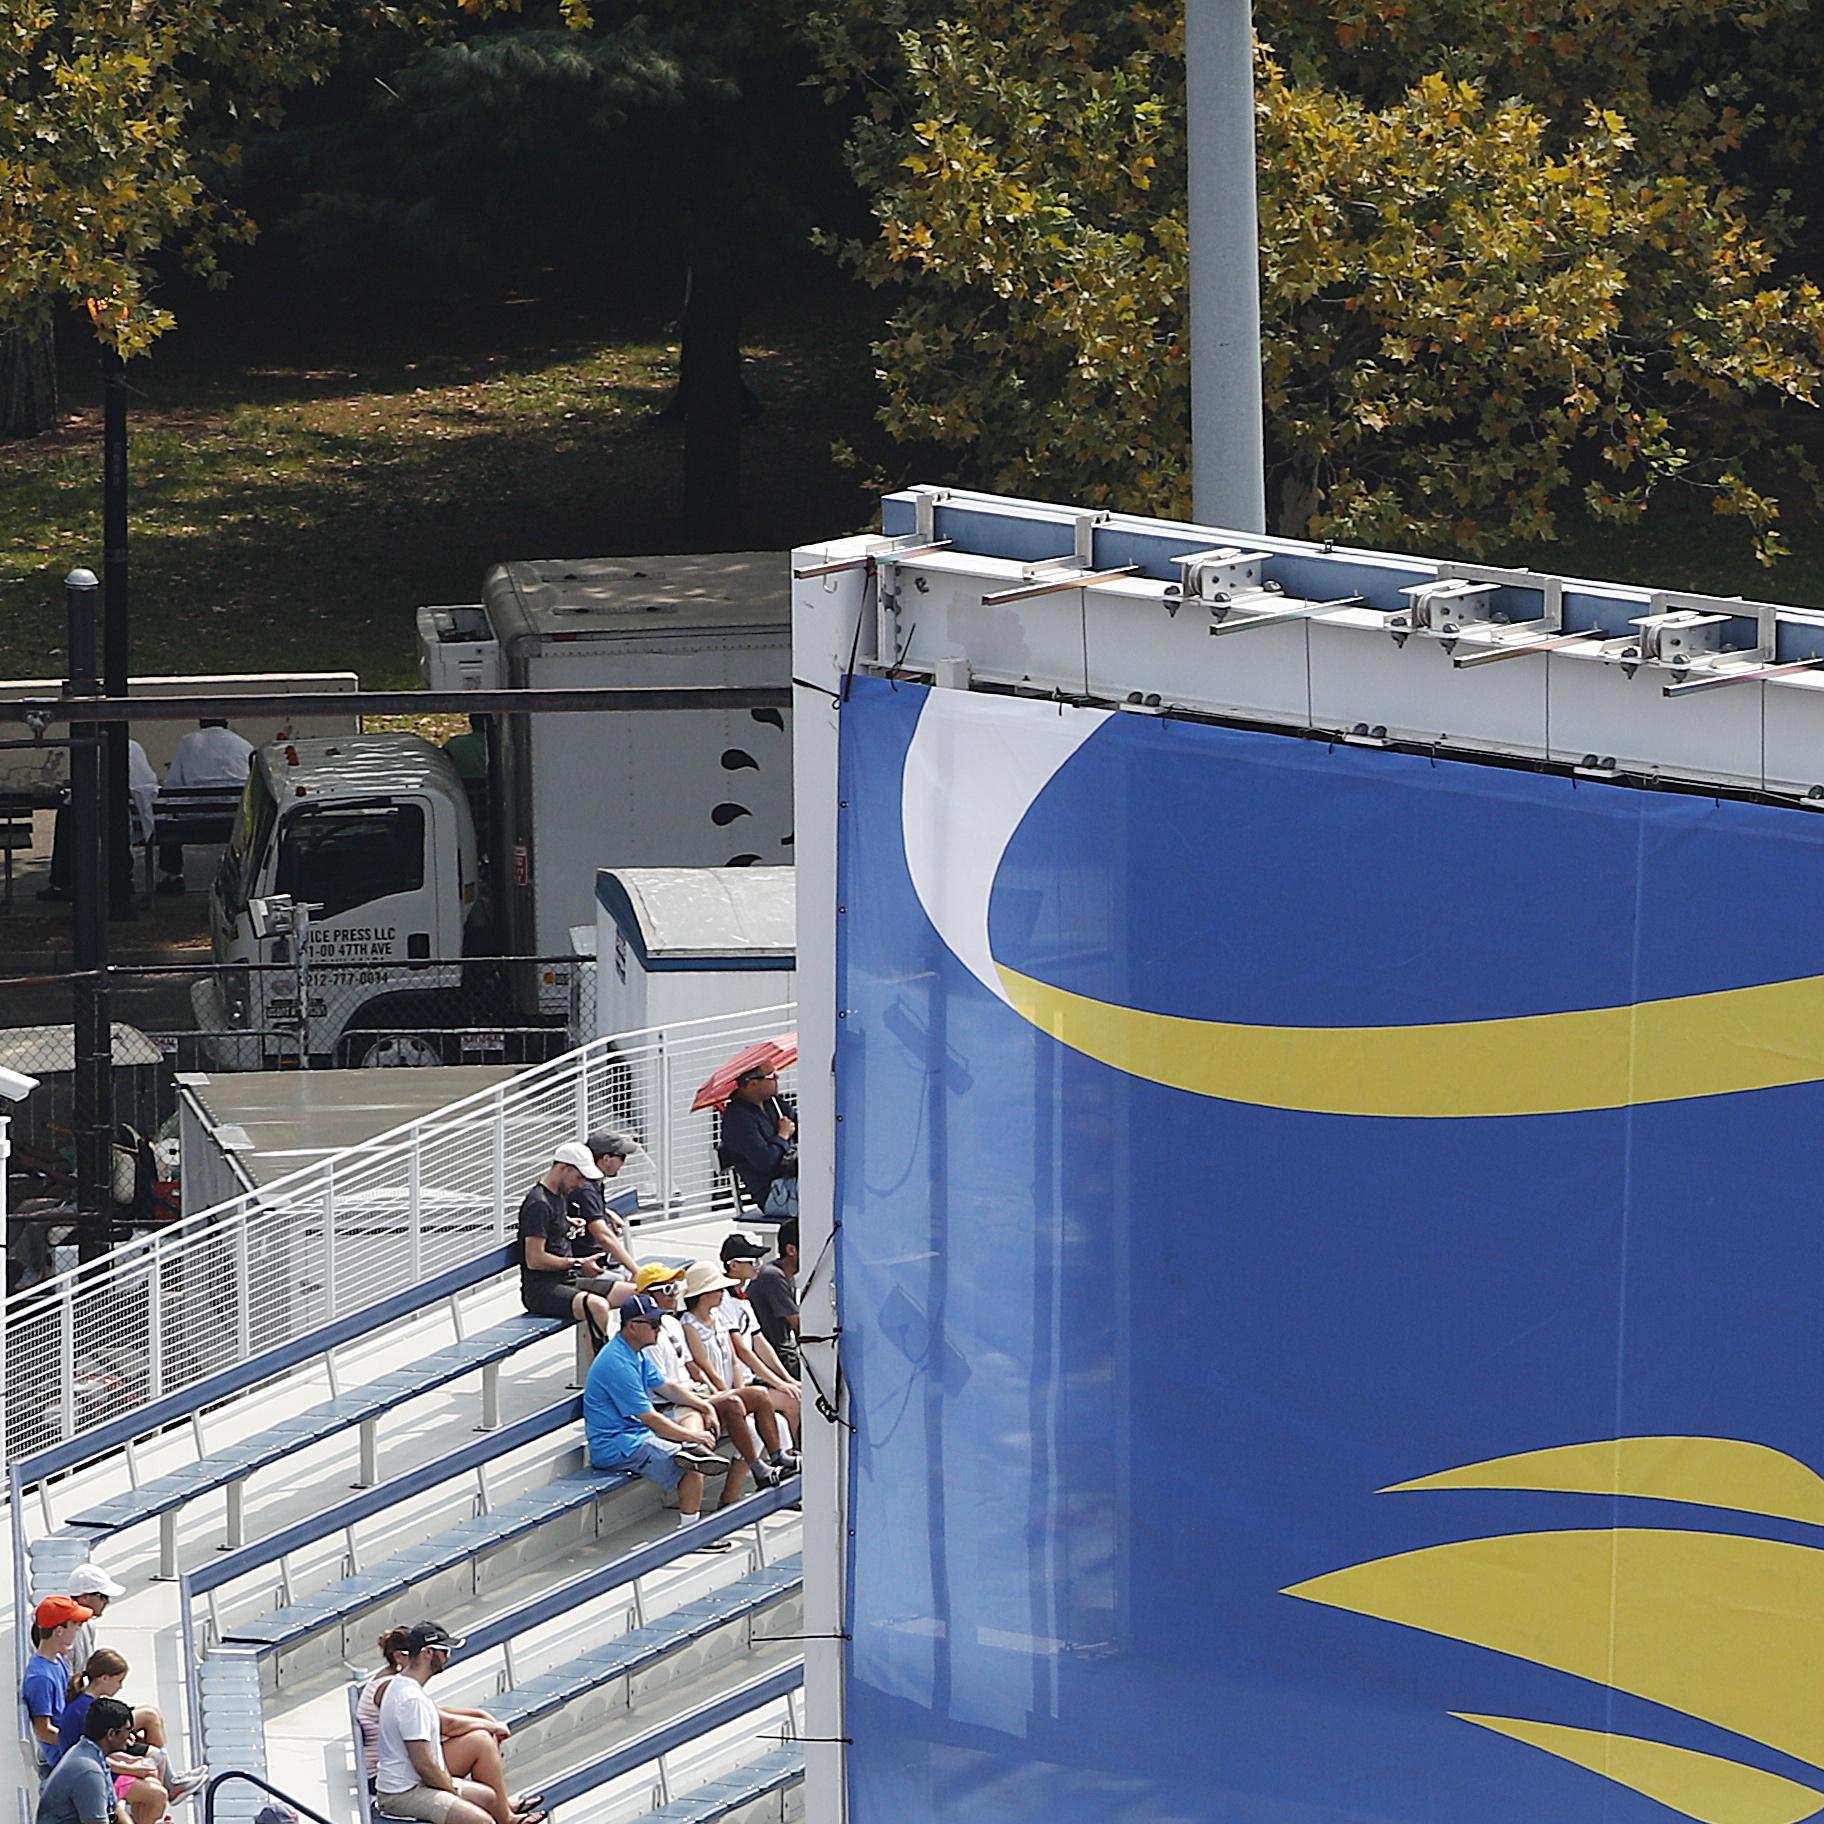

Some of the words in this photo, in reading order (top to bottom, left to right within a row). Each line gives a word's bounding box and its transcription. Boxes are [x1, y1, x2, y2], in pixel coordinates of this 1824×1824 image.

[305, 930, 329, 943] ICE
[333, 928, 371, 942] PRESS
[374, 927, 396, 940] LLC
[301, 943, 335, 957] 1-00
[338, 942, 368, 956] 47TH
[370, 941, 393, 955] AVE
